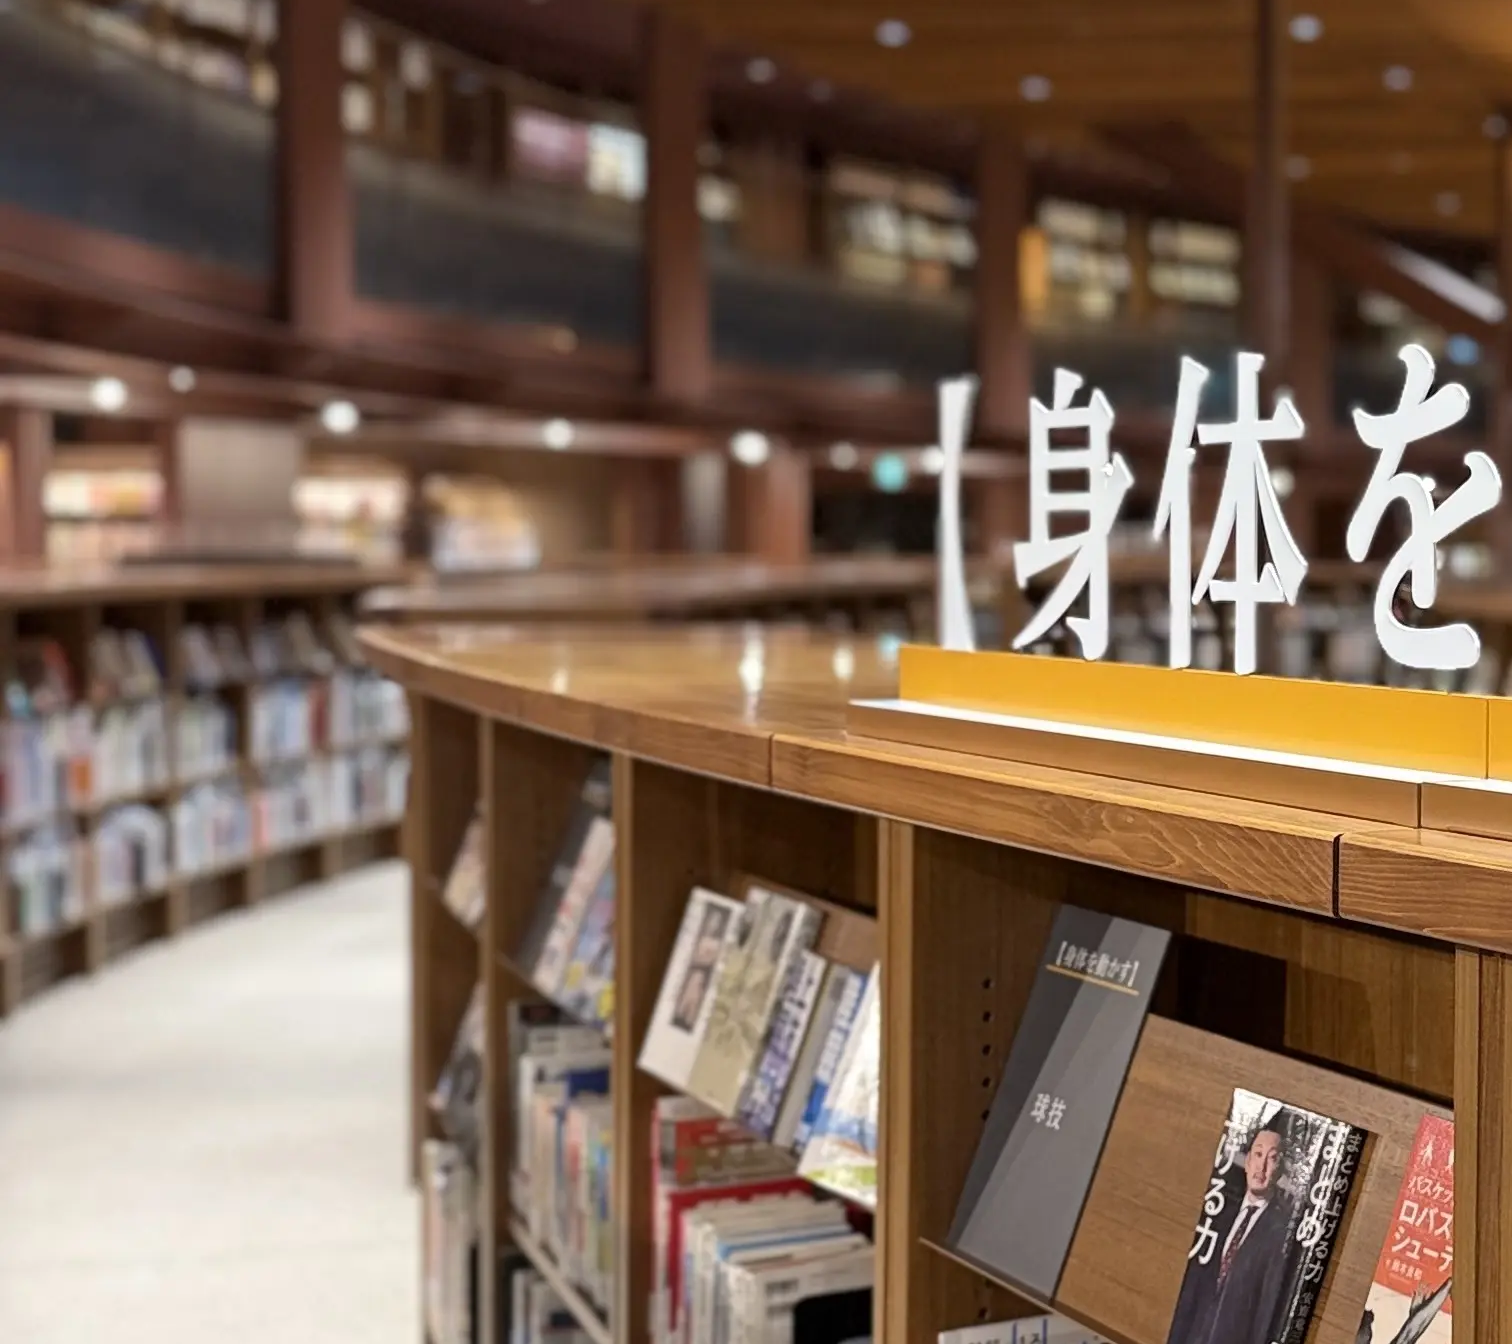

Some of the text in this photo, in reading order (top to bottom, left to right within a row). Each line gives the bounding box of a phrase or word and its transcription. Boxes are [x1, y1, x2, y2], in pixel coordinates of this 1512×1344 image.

[1029, 1091, 1067, 1131] 球技
[1303, 1133, 1364, 1284] まとめ上げる力
